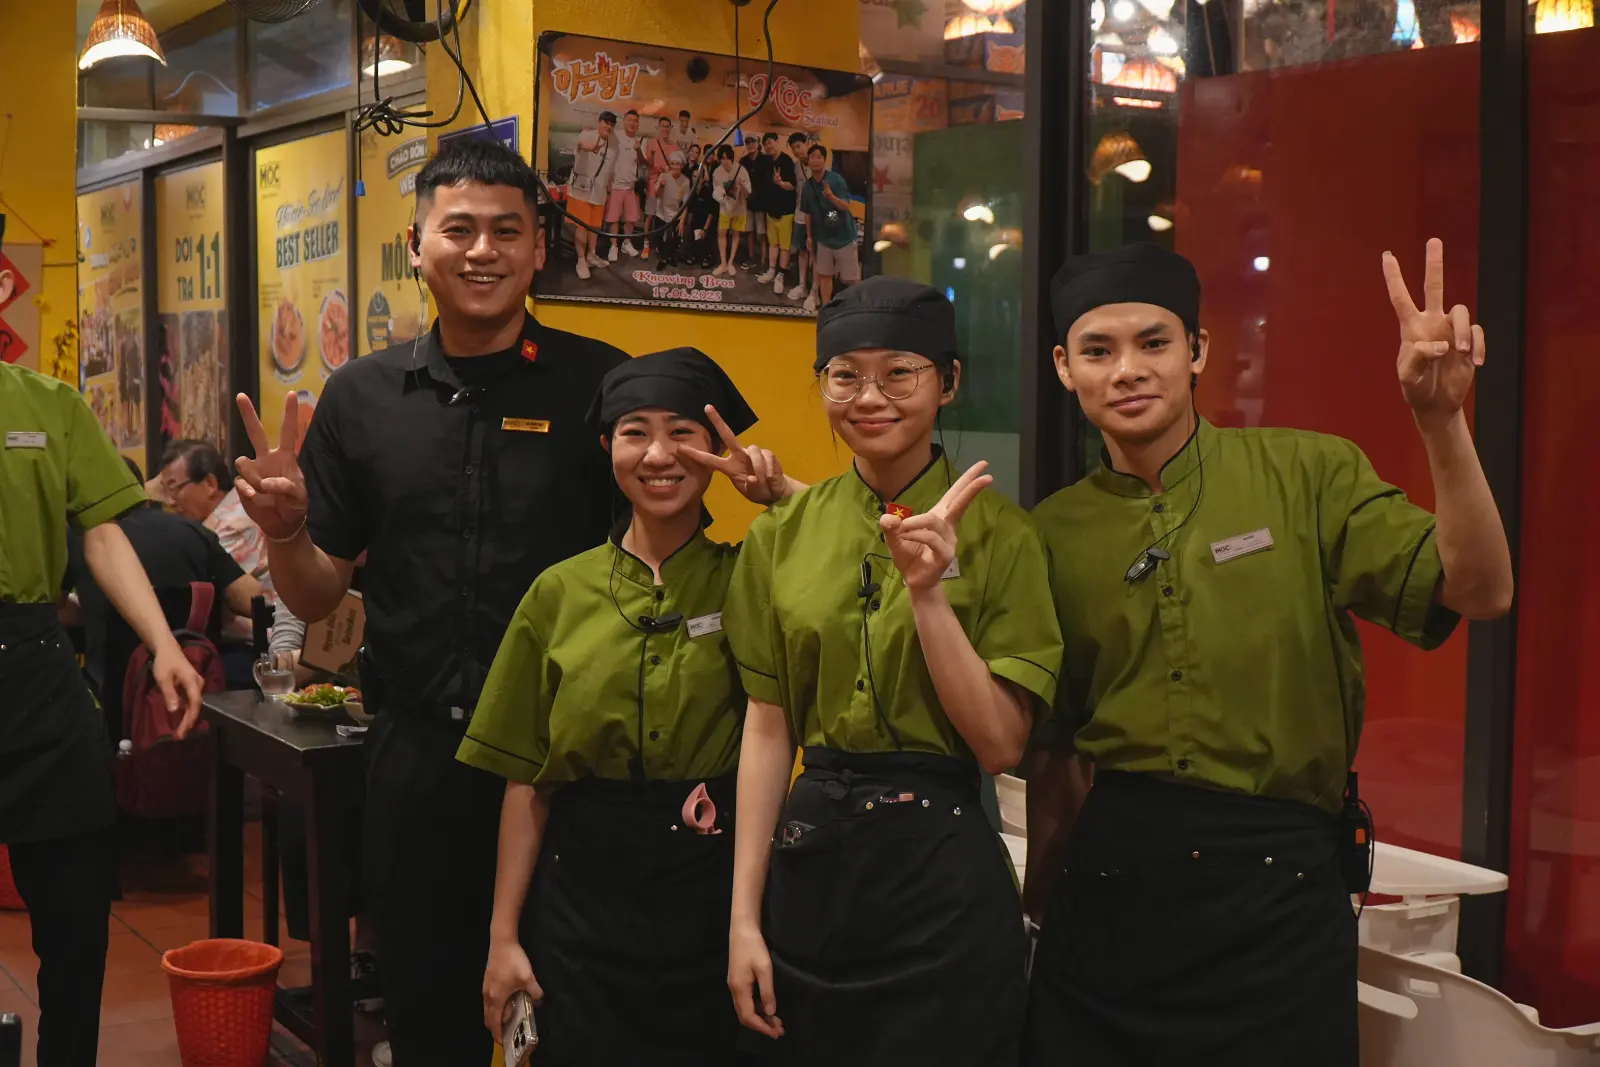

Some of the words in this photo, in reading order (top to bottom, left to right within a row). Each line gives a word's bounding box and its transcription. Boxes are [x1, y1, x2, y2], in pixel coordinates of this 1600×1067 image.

[276, 231, 301, 269] BEST
[303, 220, 340, 263] SELLER
[631, 270, 697, 289] Knowing
[698, 273, 736, 289] Bros
